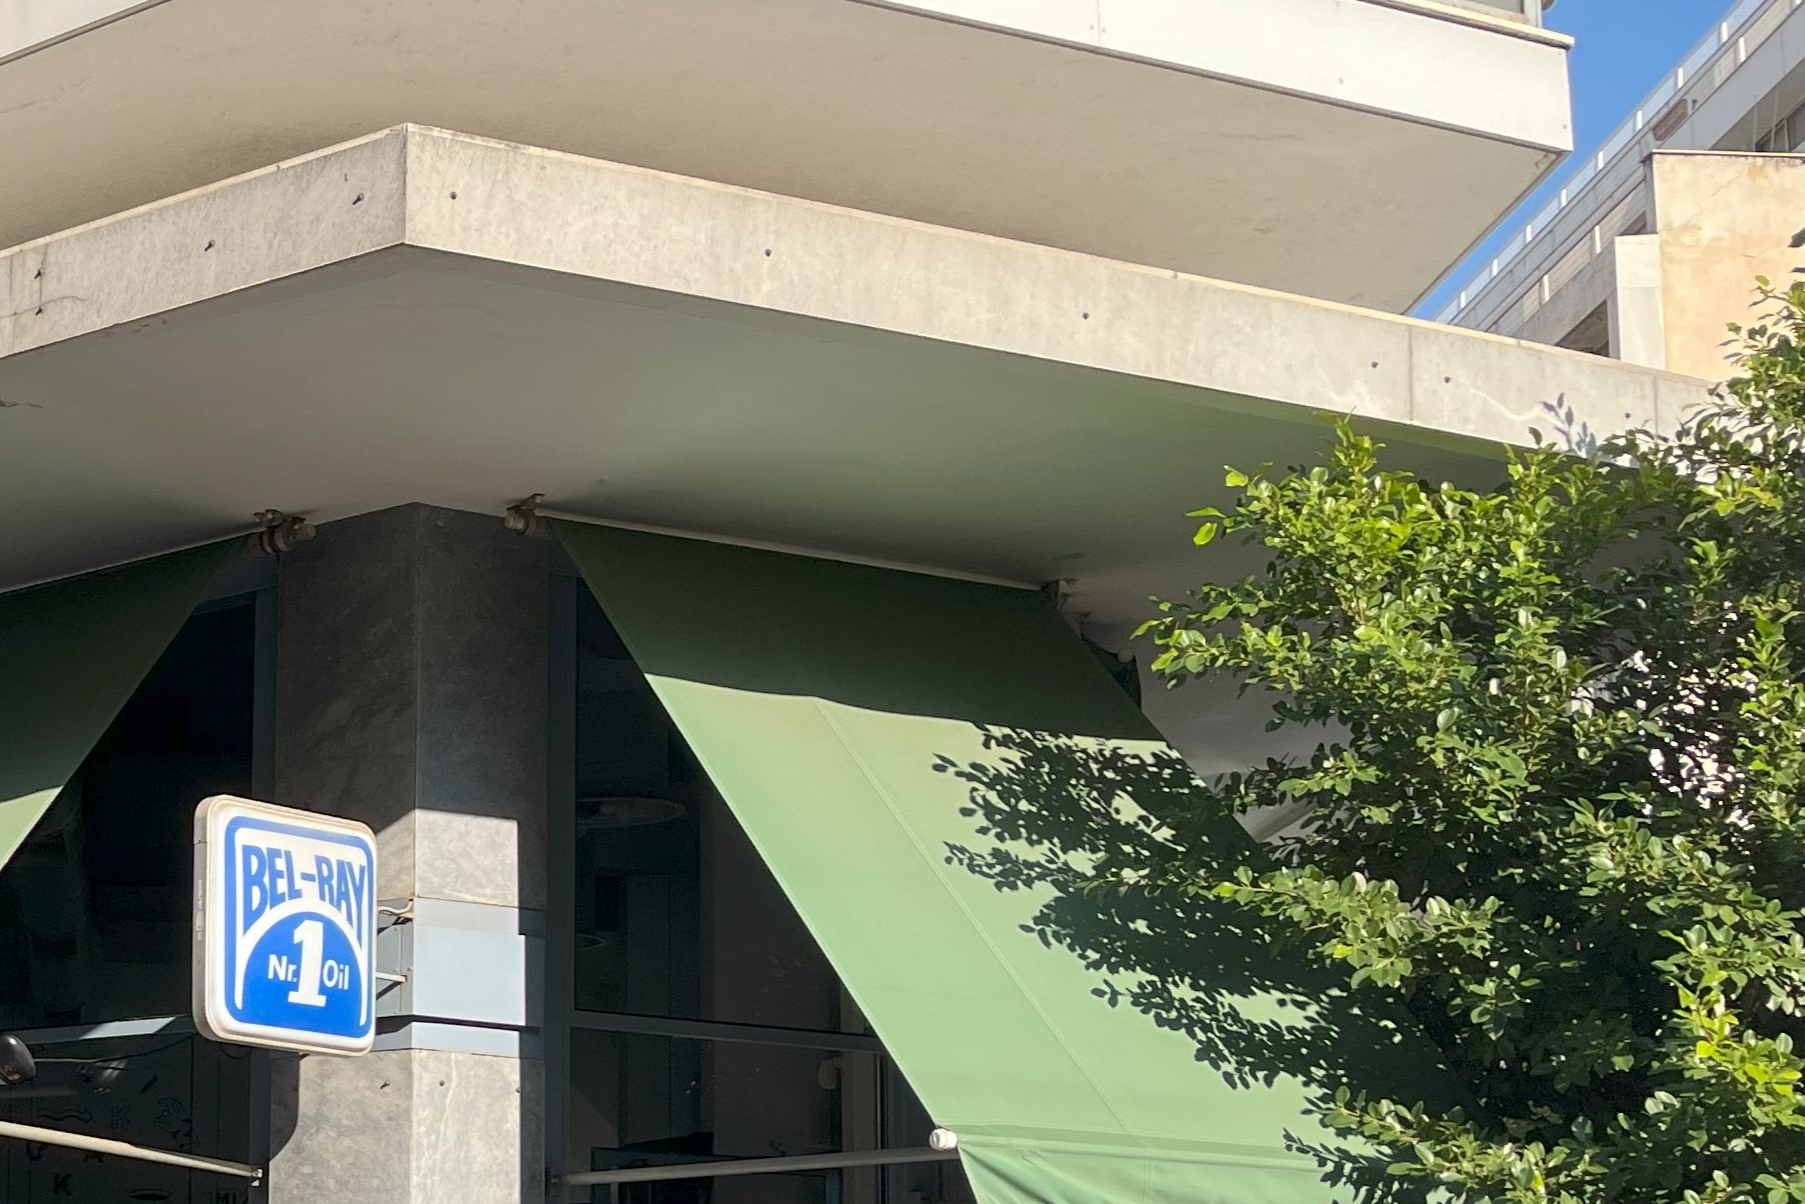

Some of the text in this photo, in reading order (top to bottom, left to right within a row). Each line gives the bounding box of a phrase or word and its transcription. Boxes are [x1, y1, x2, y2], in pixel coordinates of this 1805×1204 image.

[241, 844, 366, 951] BEL-RAY
[268, 919, 350, 1008] Nr. 1 Oil
